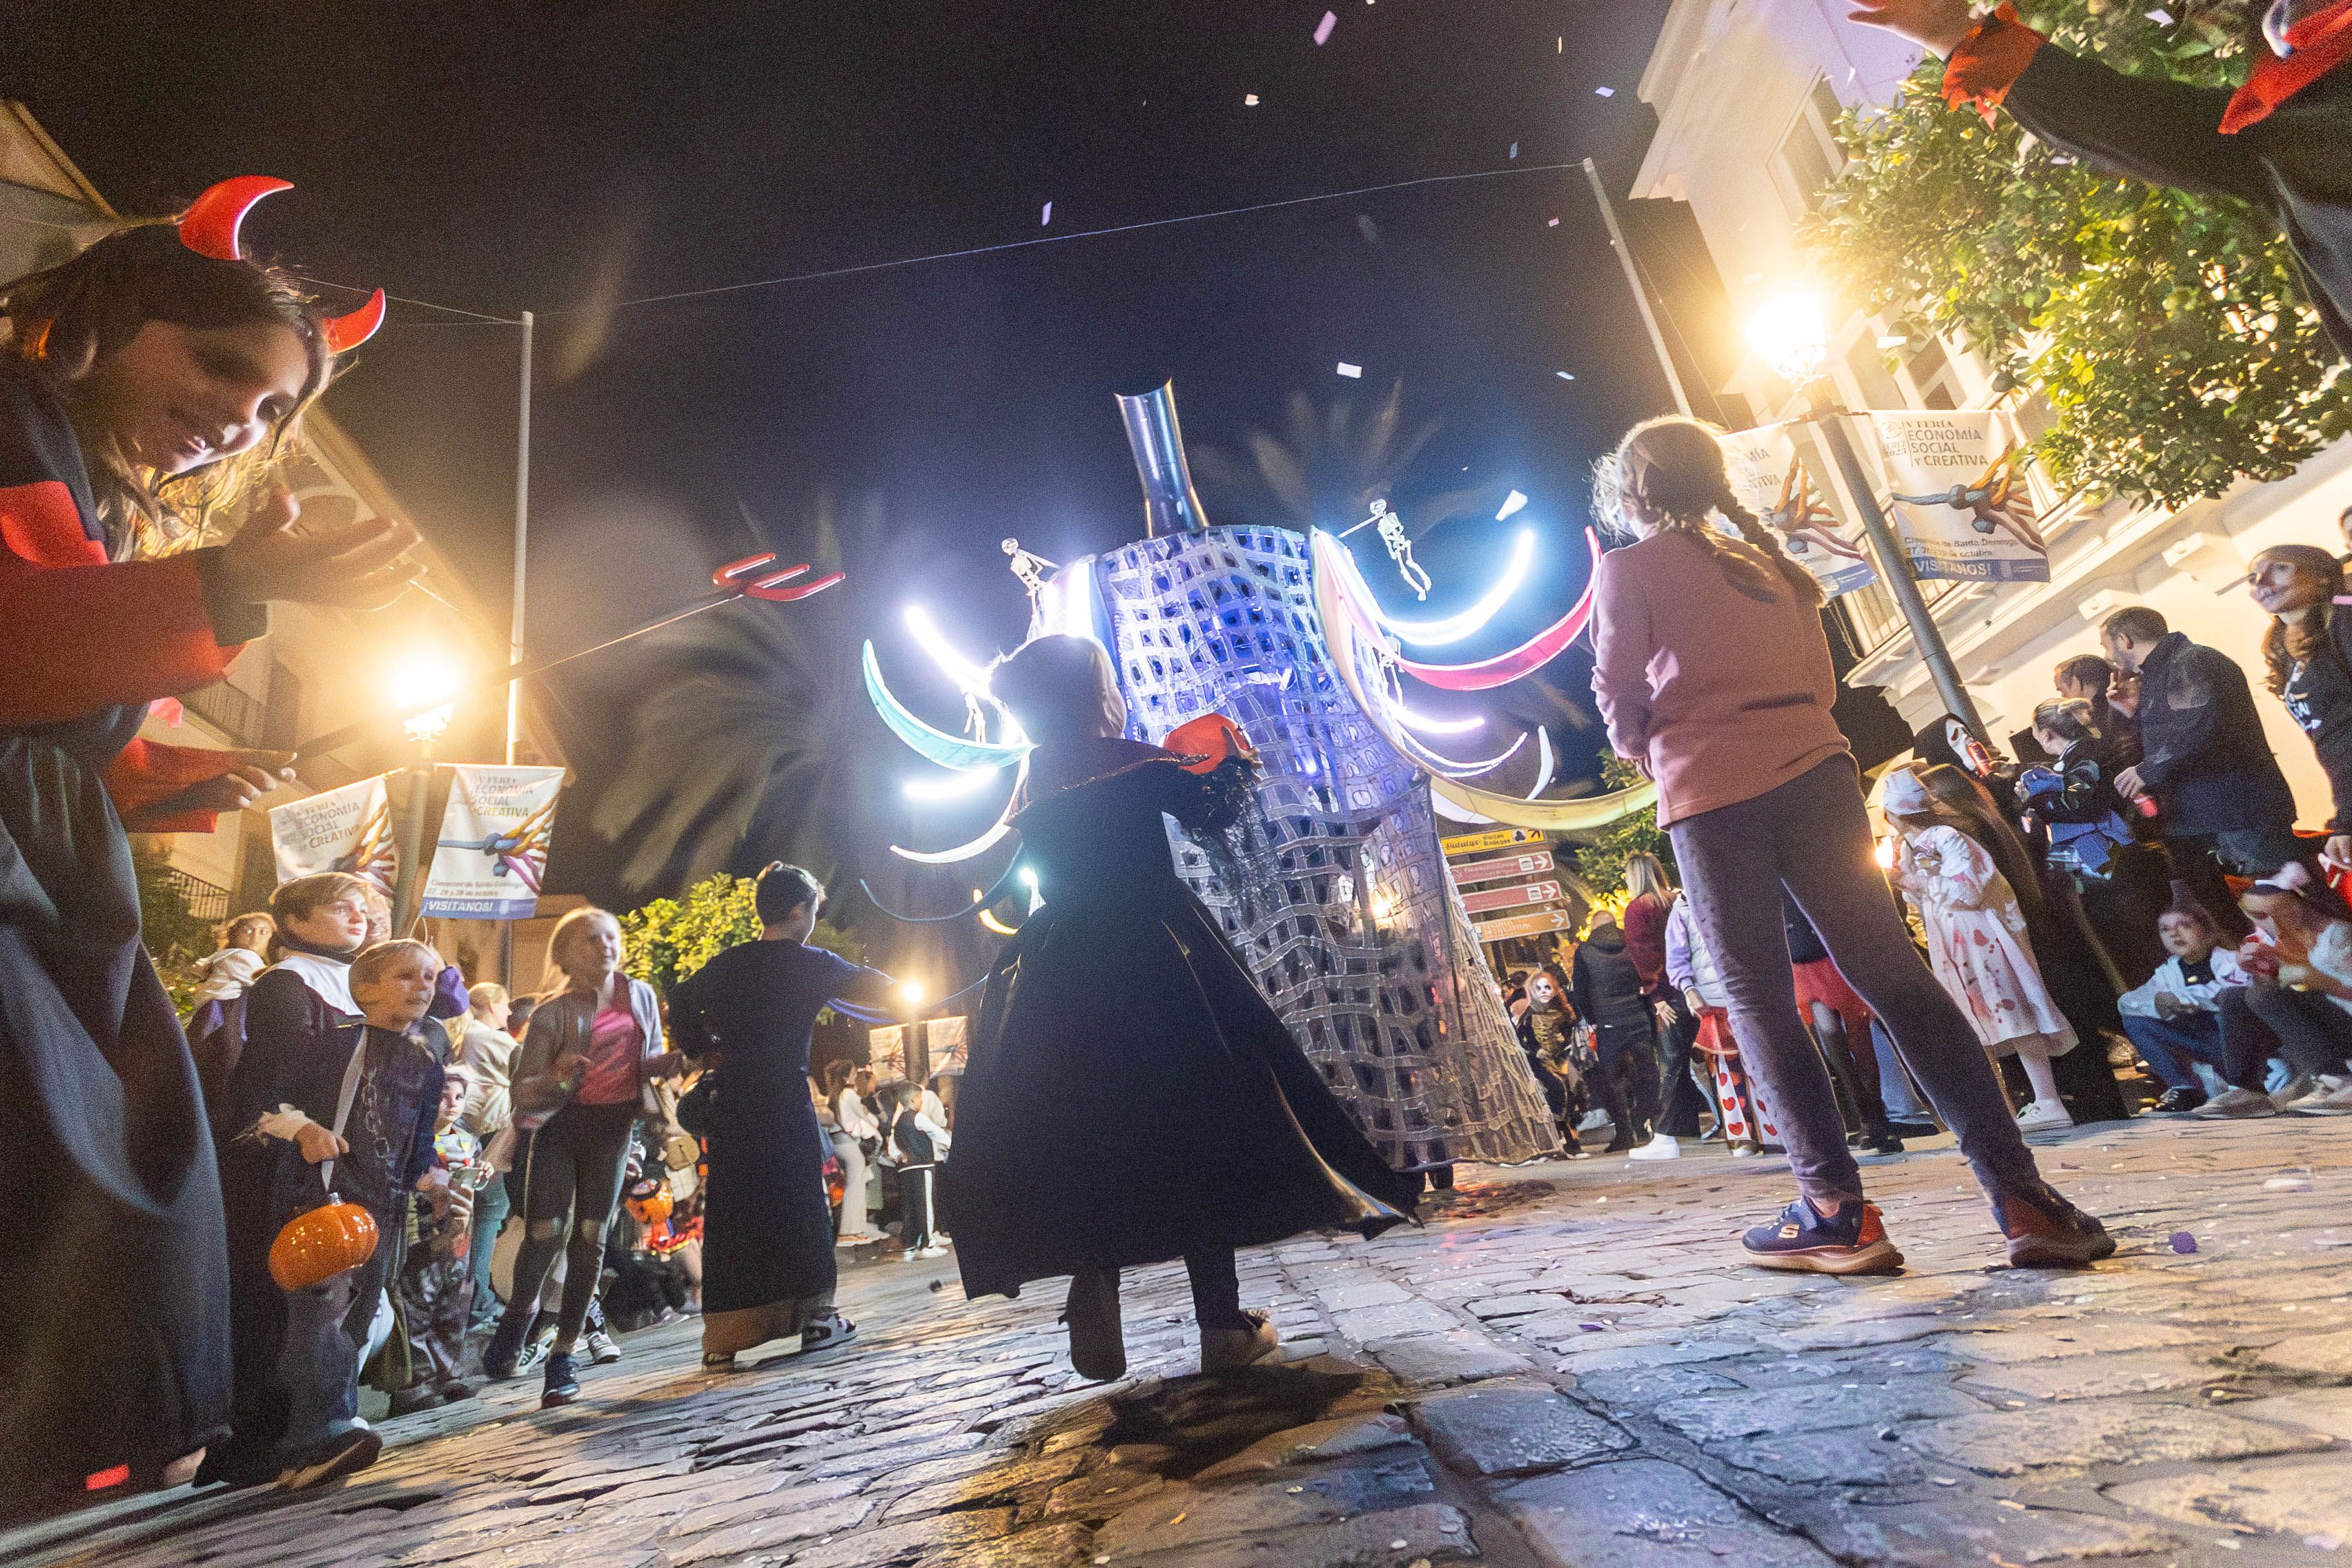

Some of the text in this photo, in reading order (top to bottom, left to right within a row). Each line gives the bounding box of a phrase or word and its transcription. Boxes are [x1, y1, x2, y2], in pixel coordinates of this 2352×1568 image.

[1908, 427, 1983, 440] ECONOMÍA
[1912, 442, 1960, 453] SOCIAL
[1923, 455, 1989, 467] CREATIVA
[302, 801, 360, 825] CONOMÍA
